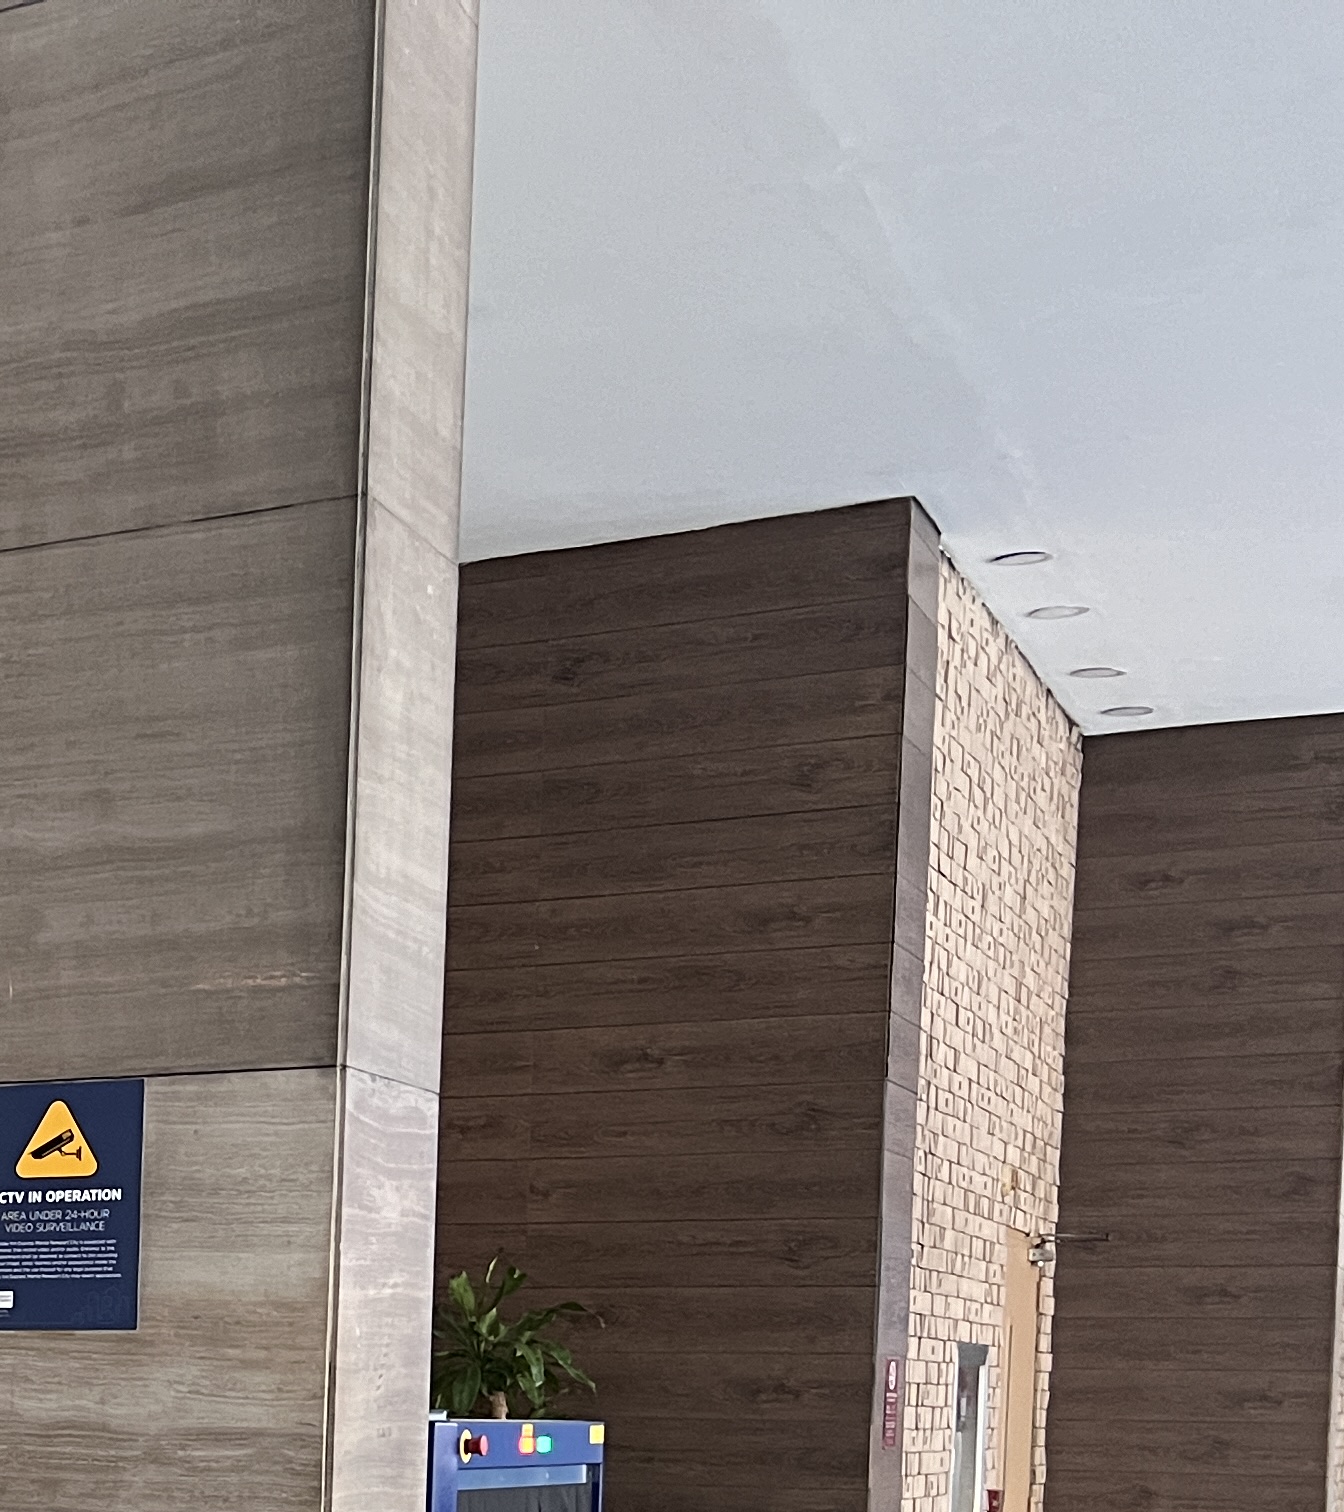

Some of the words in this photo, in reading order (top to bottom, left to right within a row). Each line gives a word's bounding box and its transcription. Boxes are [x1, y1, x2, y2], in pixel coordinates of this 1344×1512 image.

[28, 1190, 43, 1203] IN
[45, 1188, 122, 1203] OPERATION
[0, 1210, 27, 1221] AREA
[29, 1210, 63, 1221] UNDER
[65, 1208, 110, 1219] 24-HOUR
[4, 1222, 33, 1233] VIDEO
[35, 1220, 106, 1233] SURVEILLANCE
